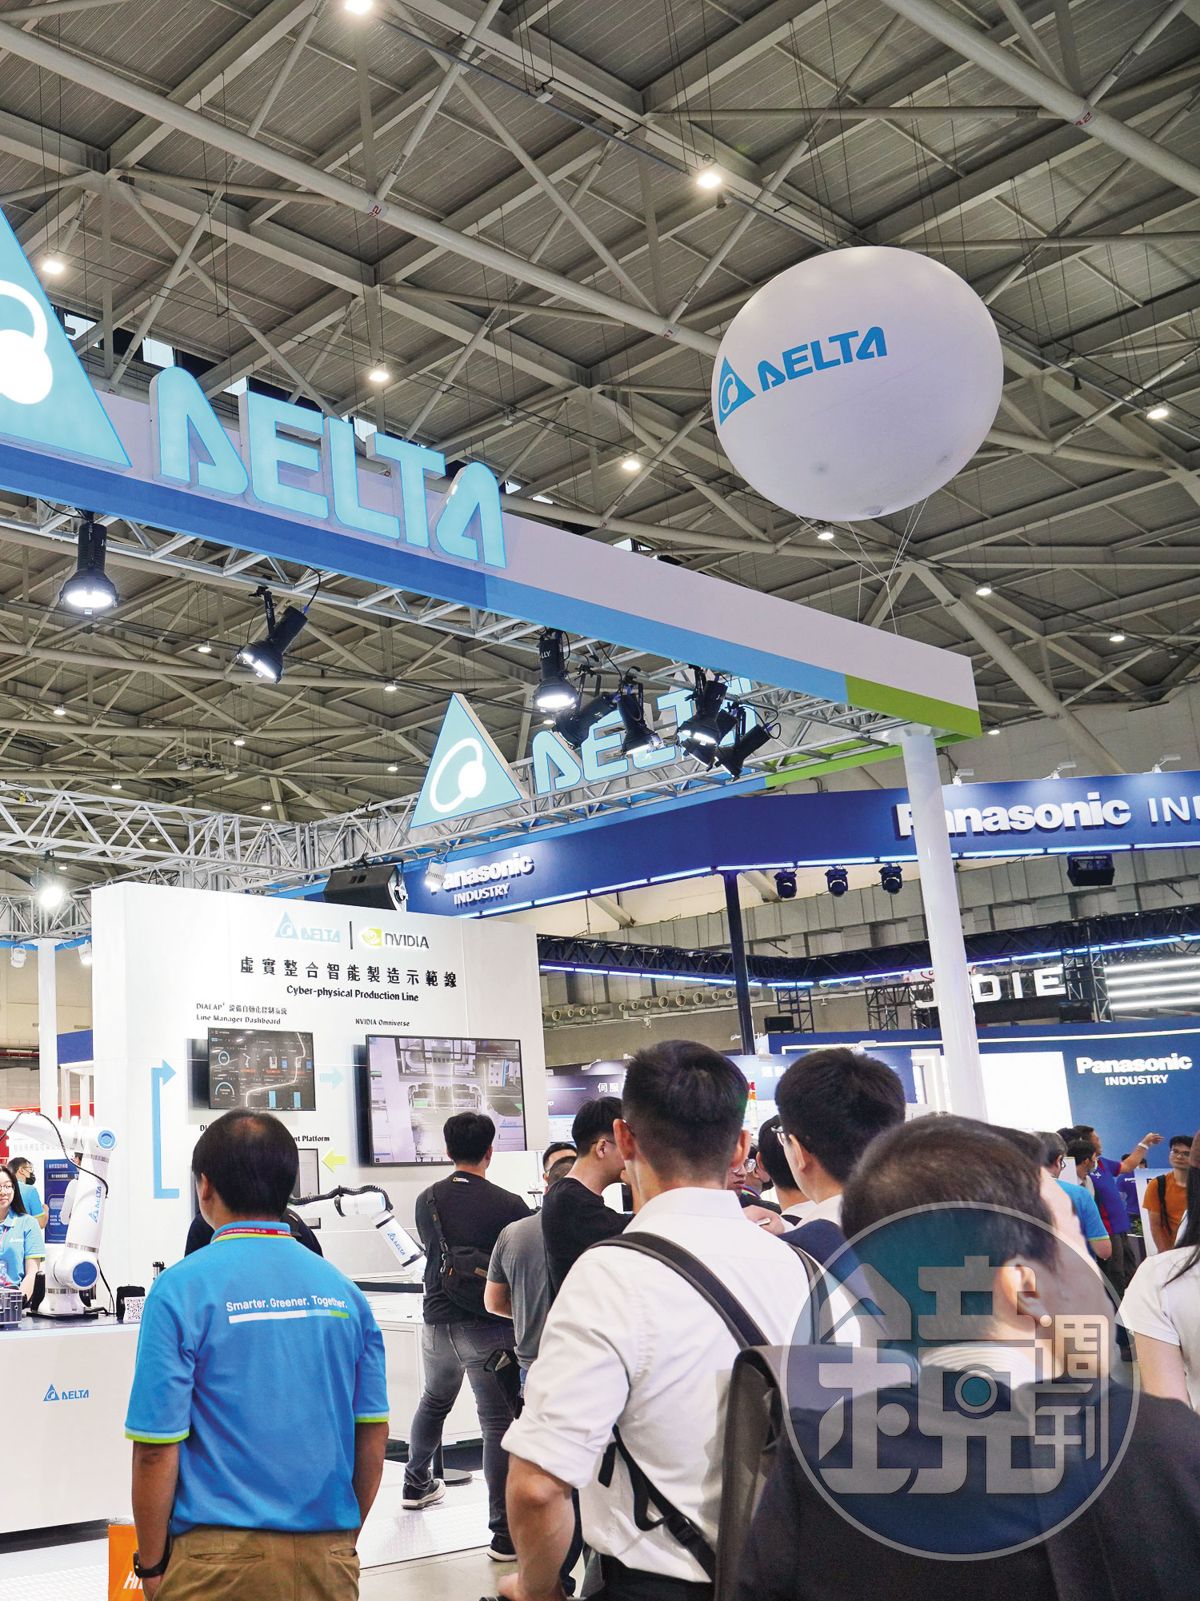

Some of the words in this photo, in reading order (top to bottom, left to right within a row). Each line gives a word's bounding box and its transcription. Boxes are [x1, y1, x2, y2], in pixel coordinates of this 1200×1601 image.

[756, 326, 888, 392] DELTA
[149, 366, 507, 569] DELTA
[431, 852, 535, 894] anasonic
[453, 882, 511, 906] INDUSTRY
[300, 928, 341, 943] DELTA
[385, 932, 430, 949] NVIDIA
[240, 956, 458, 988] 虛實整合智能製造示範線
[286, 985, 353, 998] Cyber-physical
[354, 989, 400, 1001] Production
[401, 992, 419, 1002] Line
[213, 1014, 243, 1024] Manager
[245, 1016, 281, 1025] Dashboard
[355, 1018, 377, 1027] NVIDIA
[378, 1019, 410, 1027] Omniverse
[1076, 1053, 1193, 1075] Panasonic
[598, 1082, 626, 1093] 伺服
[1104, 1074, 1169, 1086] INDUSTRY
[302, 1135, 330, 1143] Platform
[226, 1299, 269, 1312] Smarter.
[270, 1297, 310, 1308] Greener.
[311, 1295, 348, 1308] Together.
[61, 1389, 90, 1400] DELTA
